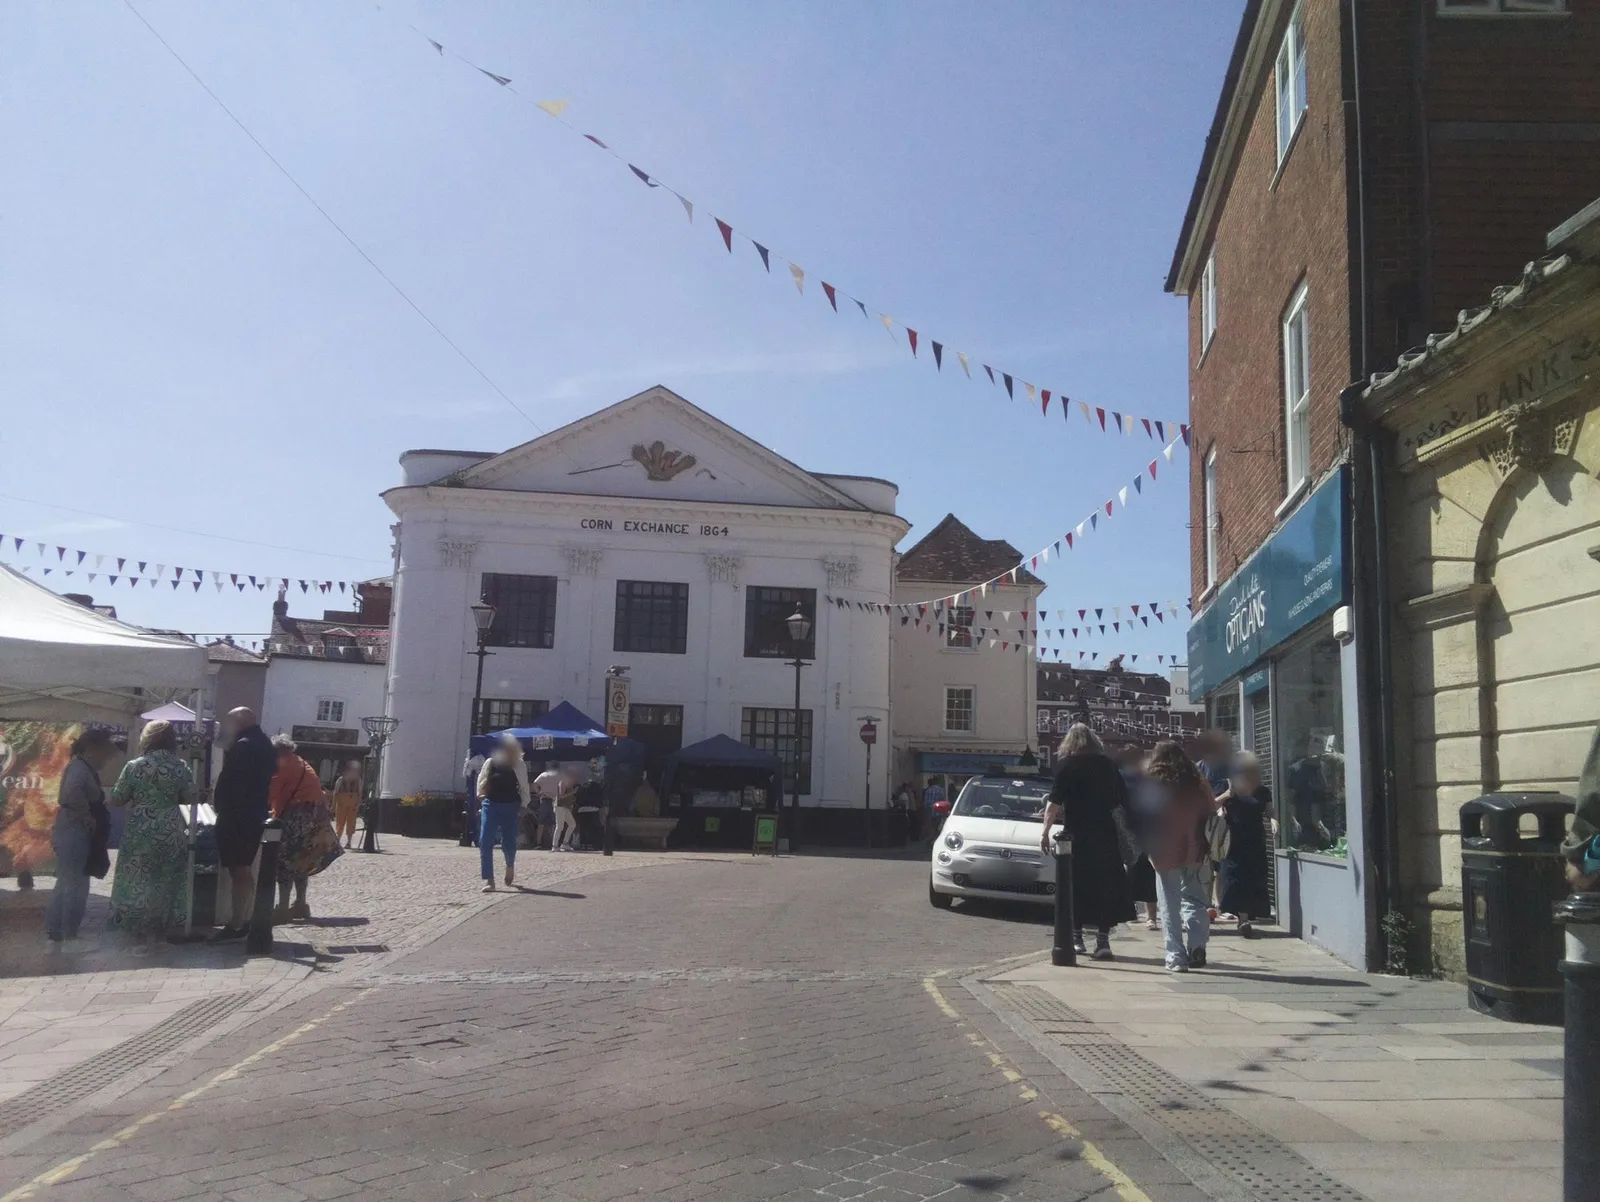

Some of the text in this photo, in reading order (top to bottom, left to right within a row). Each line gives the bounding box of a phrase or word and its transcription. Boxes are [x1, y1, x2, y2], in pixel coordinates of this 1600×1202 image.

[1475, 352, 1561, 420] BANK
[580, 518, 729, 536] CORN EXCHANGE 1864
[1226, 590, 1266, 654] OPTICIANS
